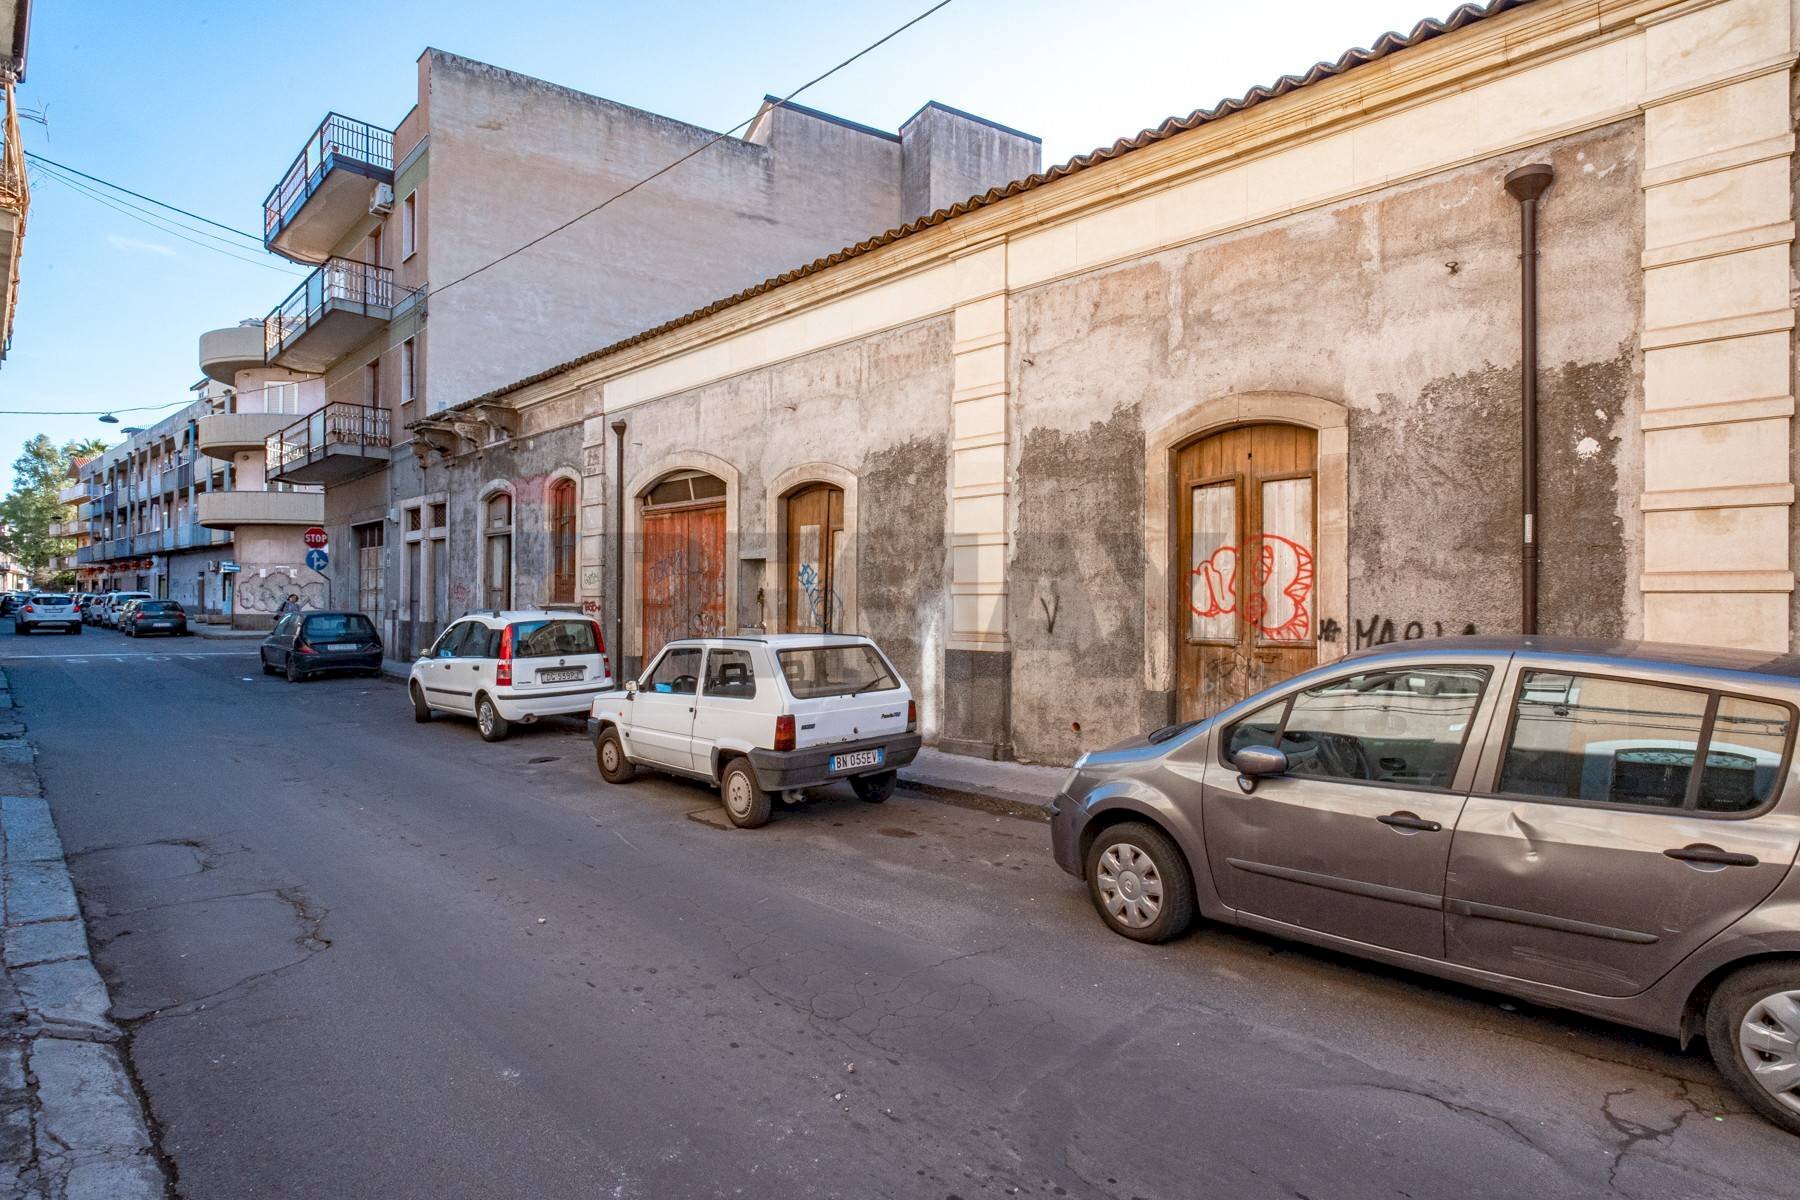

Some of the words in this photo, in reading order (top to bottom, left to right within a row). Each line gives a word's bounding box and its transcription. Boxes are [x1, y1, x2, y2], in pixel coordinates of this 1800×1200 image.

[305, 534, 327, 543] STOP
[836, 756, 848, 769] BN
[850, 751, 876, 766] 055EV
